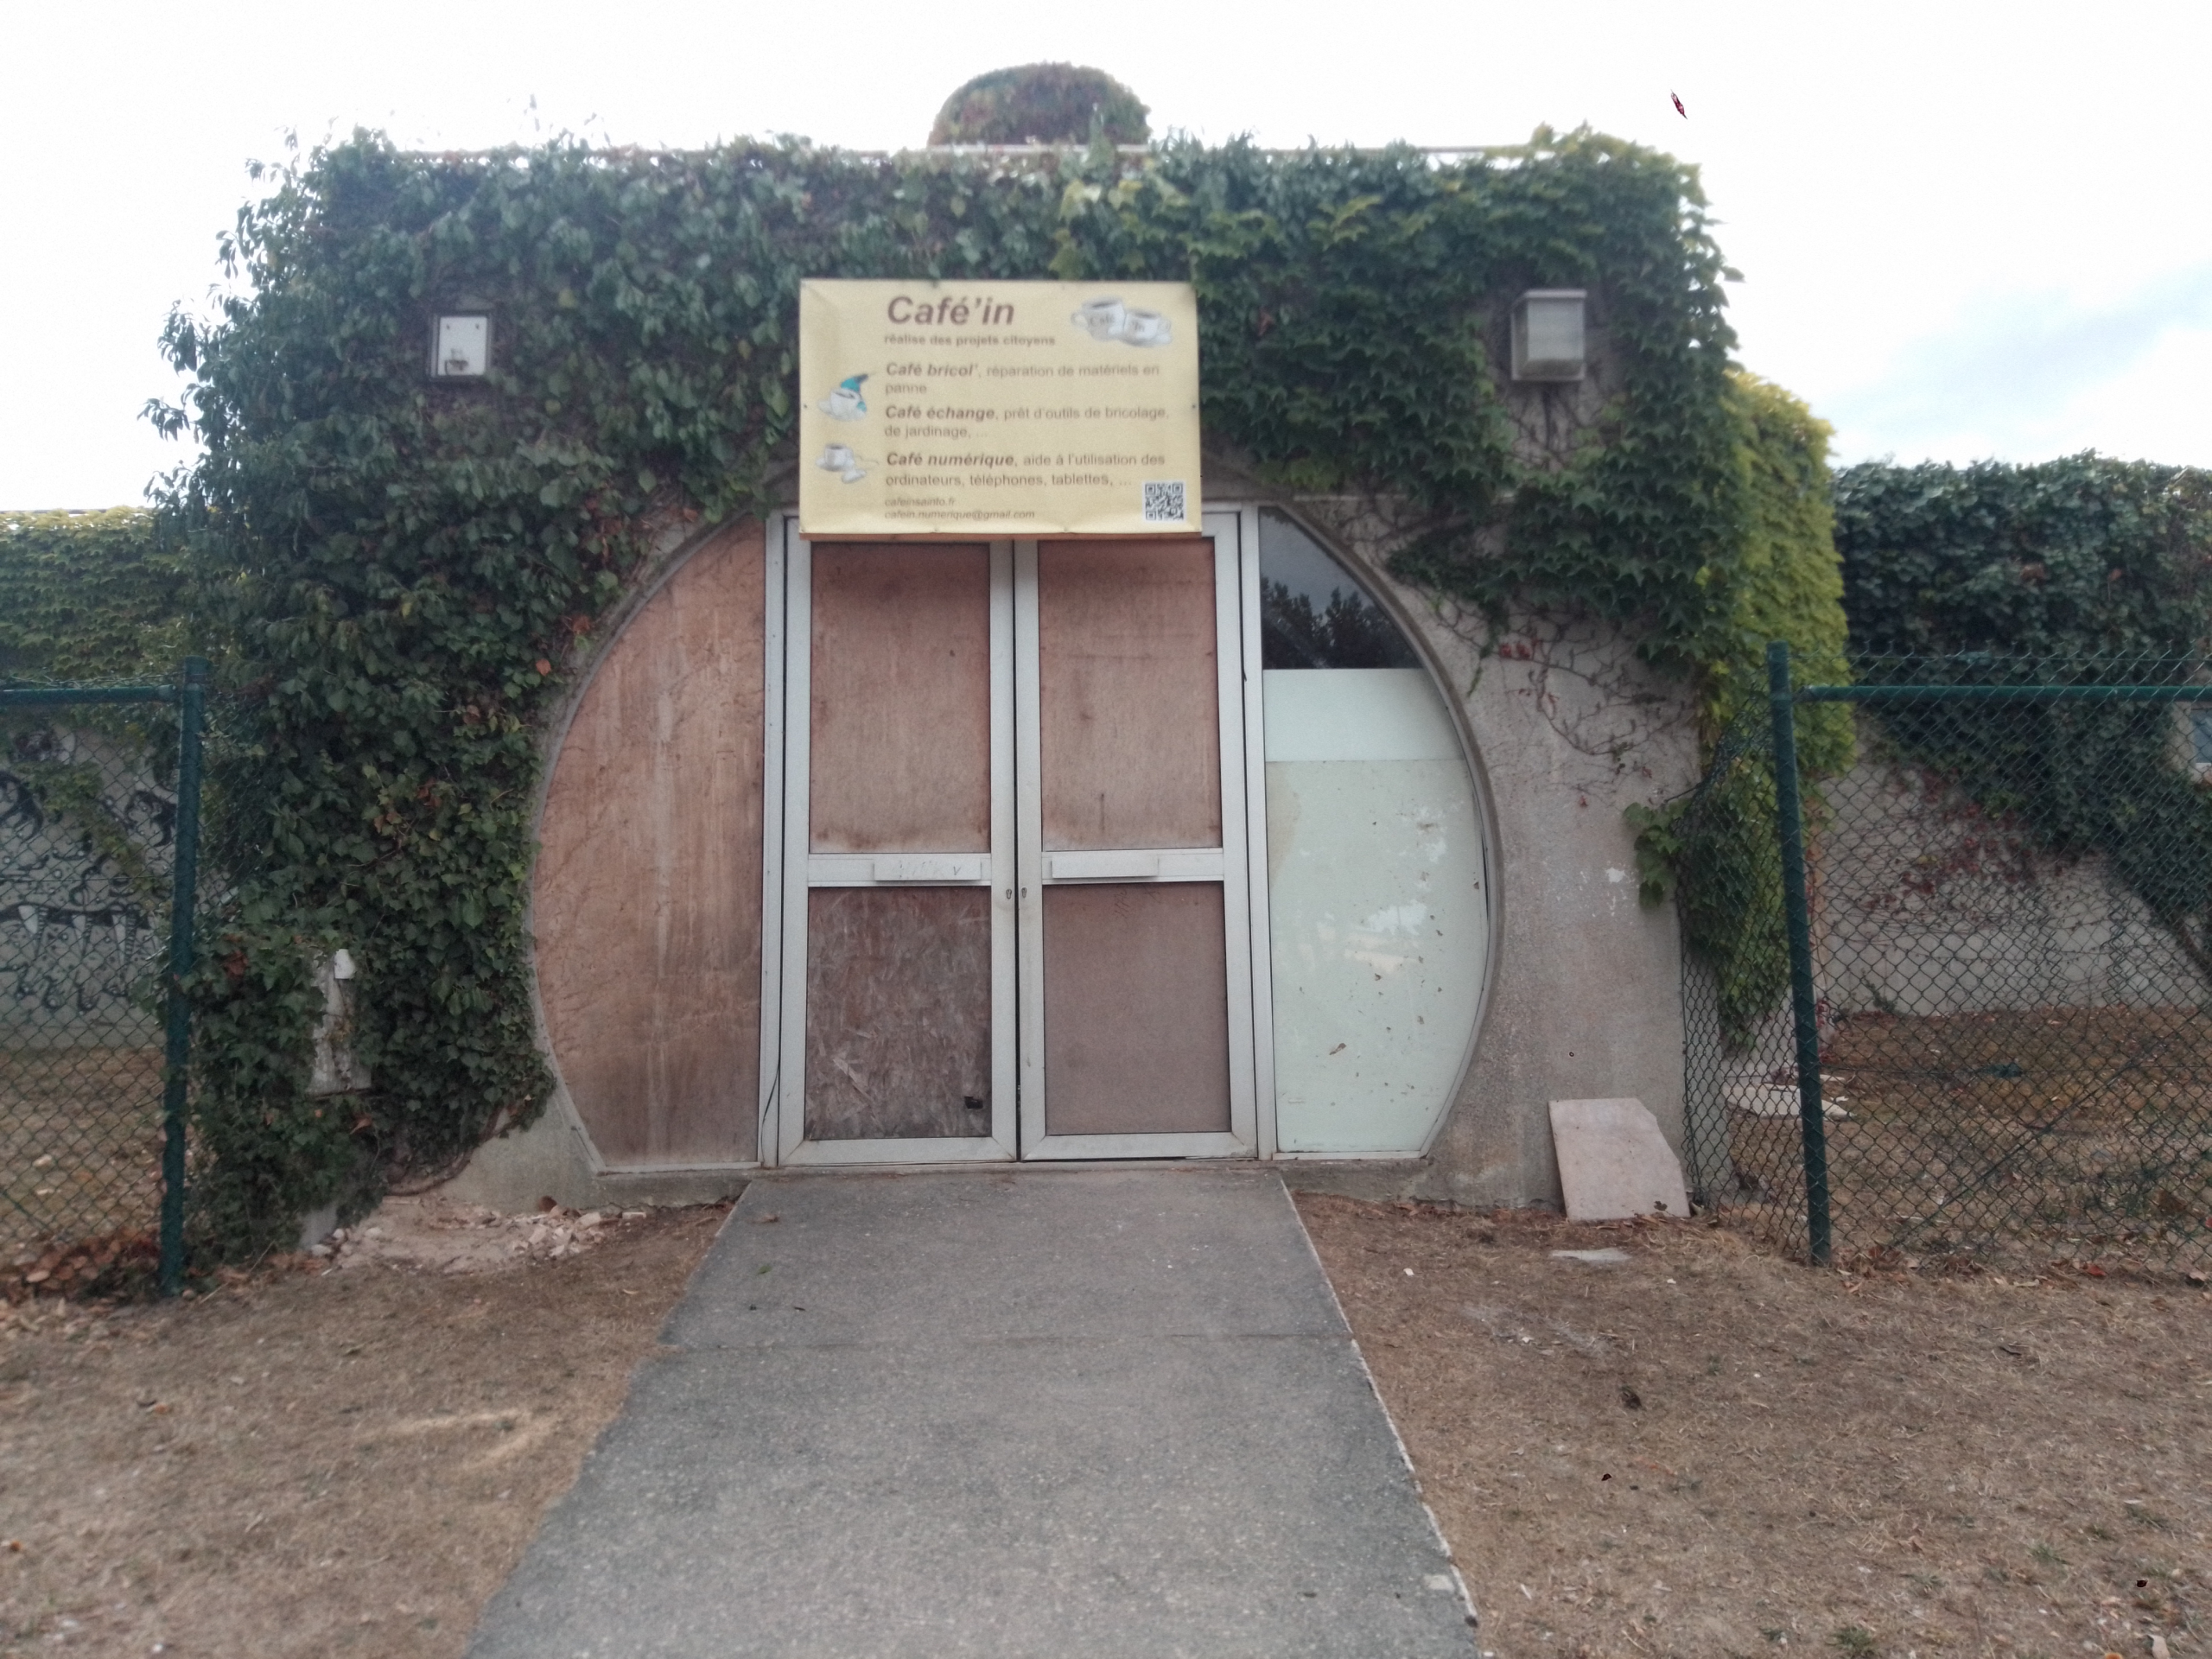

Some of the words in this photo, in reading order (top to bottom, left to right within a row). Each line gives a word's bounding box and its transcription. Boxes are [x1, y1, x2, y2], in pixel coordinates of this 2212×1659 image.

[887, 296, 1014, 326] Café'in
[884, 334, 926, 346] réalise
[930, 334, 951, 346] des
[956, 334, 1000, 347] projets
[1003, 335, 1056, 347] citoyens
[886, 362, 923, 376] Café
[987, 364, 1054, 378] réparation
[1058, 365, 1074, 377] de
[1079, 365, 1139, 377] matériels
[1142, 366, 1160, 376] en
[885, 385, 927, 396] panne
[885, 405, 922, 419] Café
[1004, 407, 1029, 421] prêt
[1033, 407, 1080, 419] d'outils
[1084, 407, 1101, 418] de
[884, 426, 901, 437] de
[887, 453, 923, 467] Café
[1023, 454, 1052, 467] aide
[1056, 454, 1064, 466] à
[1068, 454, 1137, 467] l'utilisation
[1141, 454, 1166, 466] des
